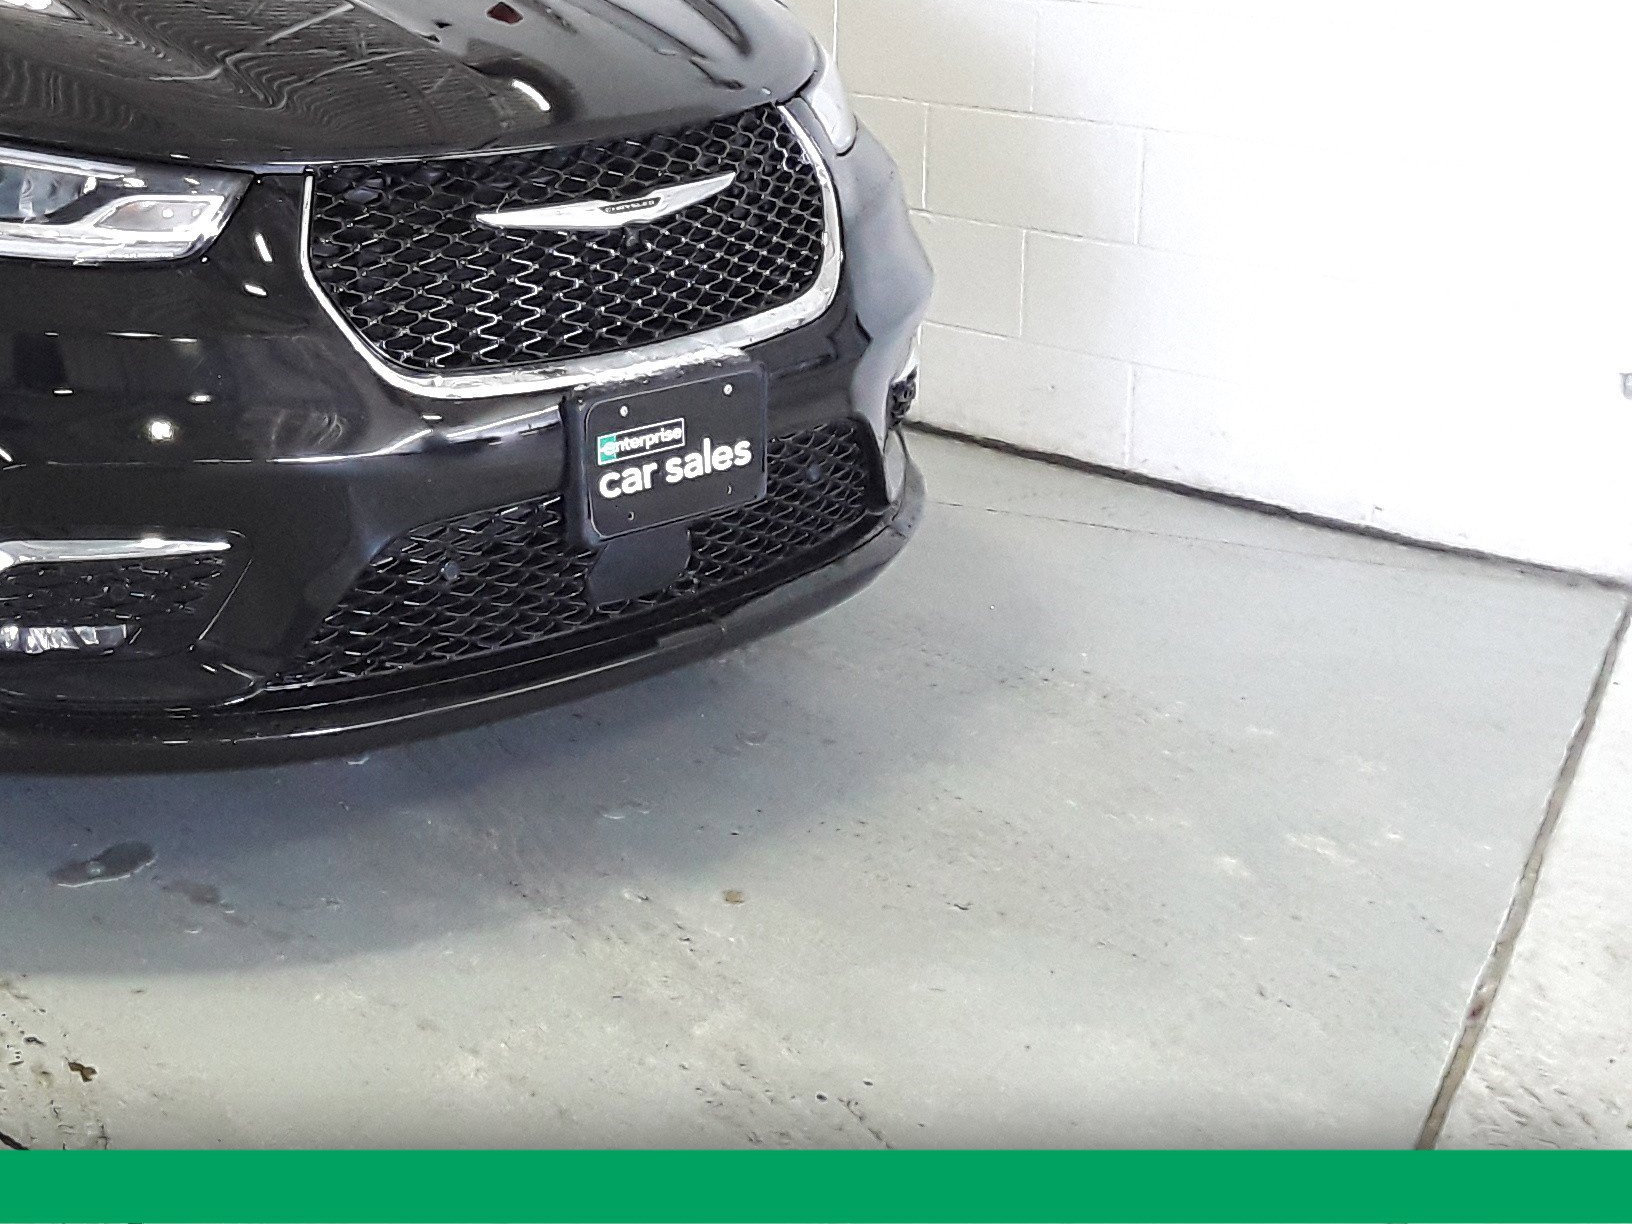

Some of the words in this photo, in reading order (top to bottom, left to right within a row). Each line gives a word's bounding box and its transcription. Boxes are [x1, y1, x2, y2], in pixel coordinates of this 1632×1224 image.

[602, 427, 683, 457] enterprise
[599, 462, 657, 498] car
[665, 438, 752, 483] sales
